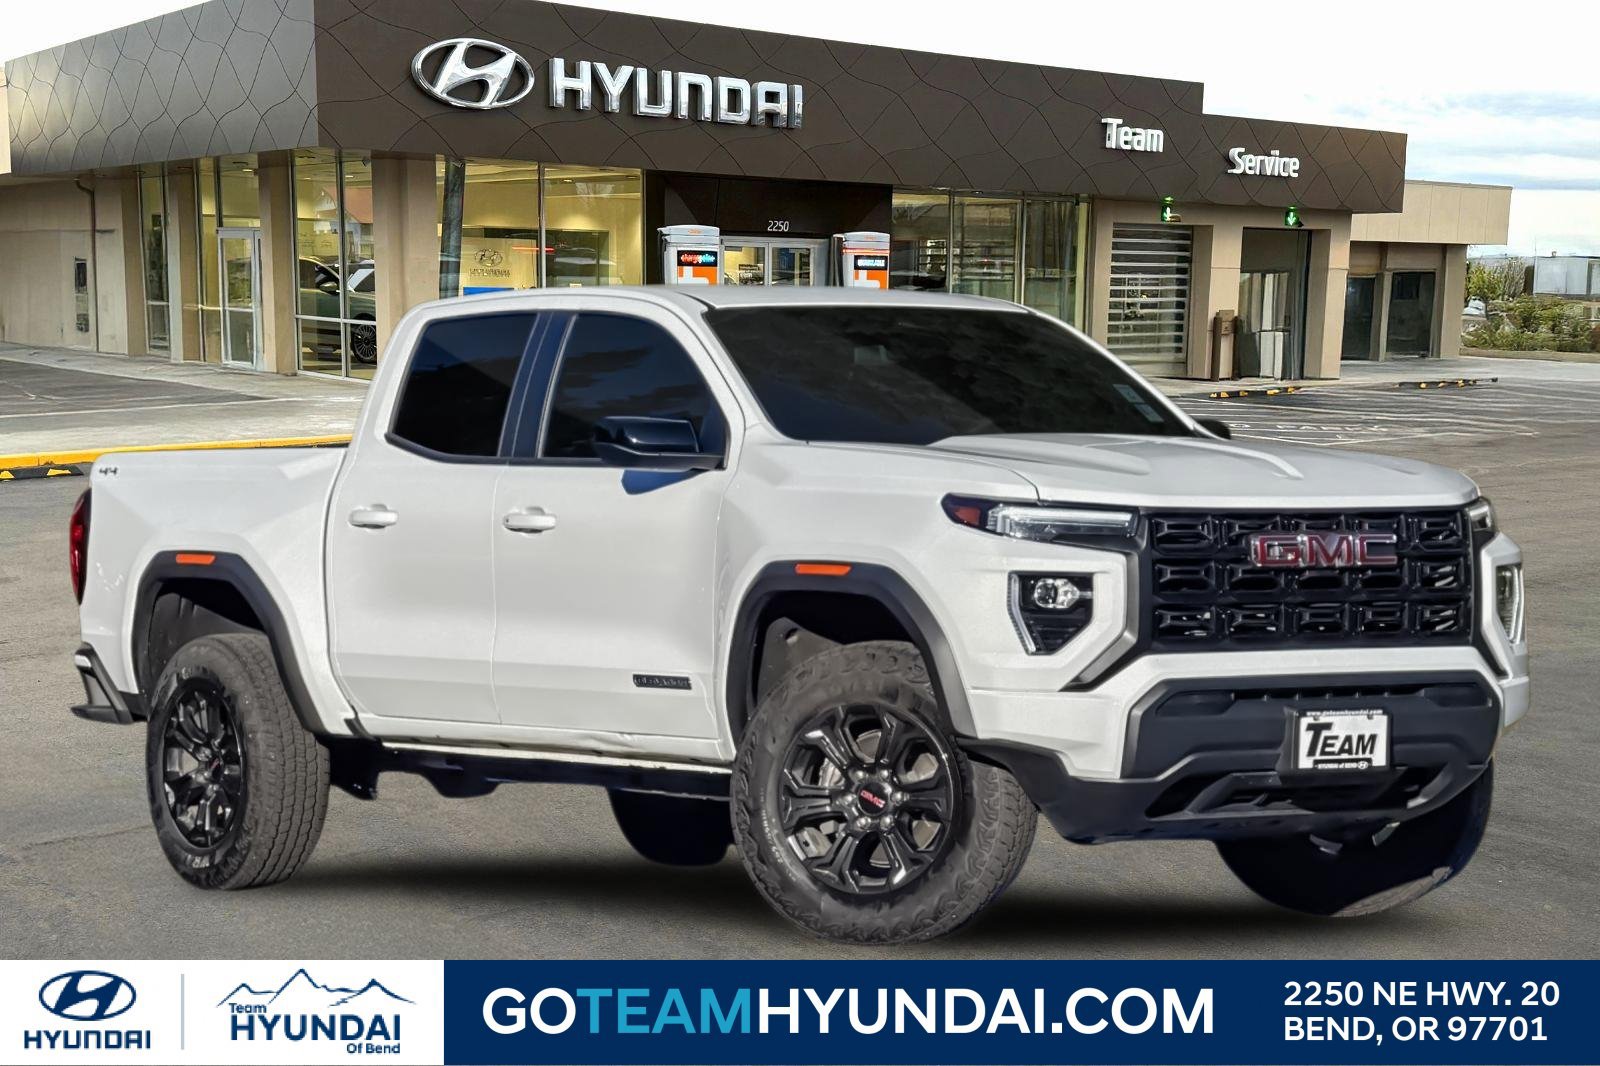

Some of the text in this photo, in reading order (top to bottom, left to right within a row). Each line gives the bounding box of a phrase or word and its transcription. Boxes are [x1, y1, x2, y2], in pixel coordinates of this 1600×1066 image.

[548, 57, 802, 129] HYUNDAI
[1101, 117, 1164, 152] Team
[1227, 147, 1300, 178] Service
[767, 220, 789, 232] 2250
[1251, 534, 1398, 567] GMC
